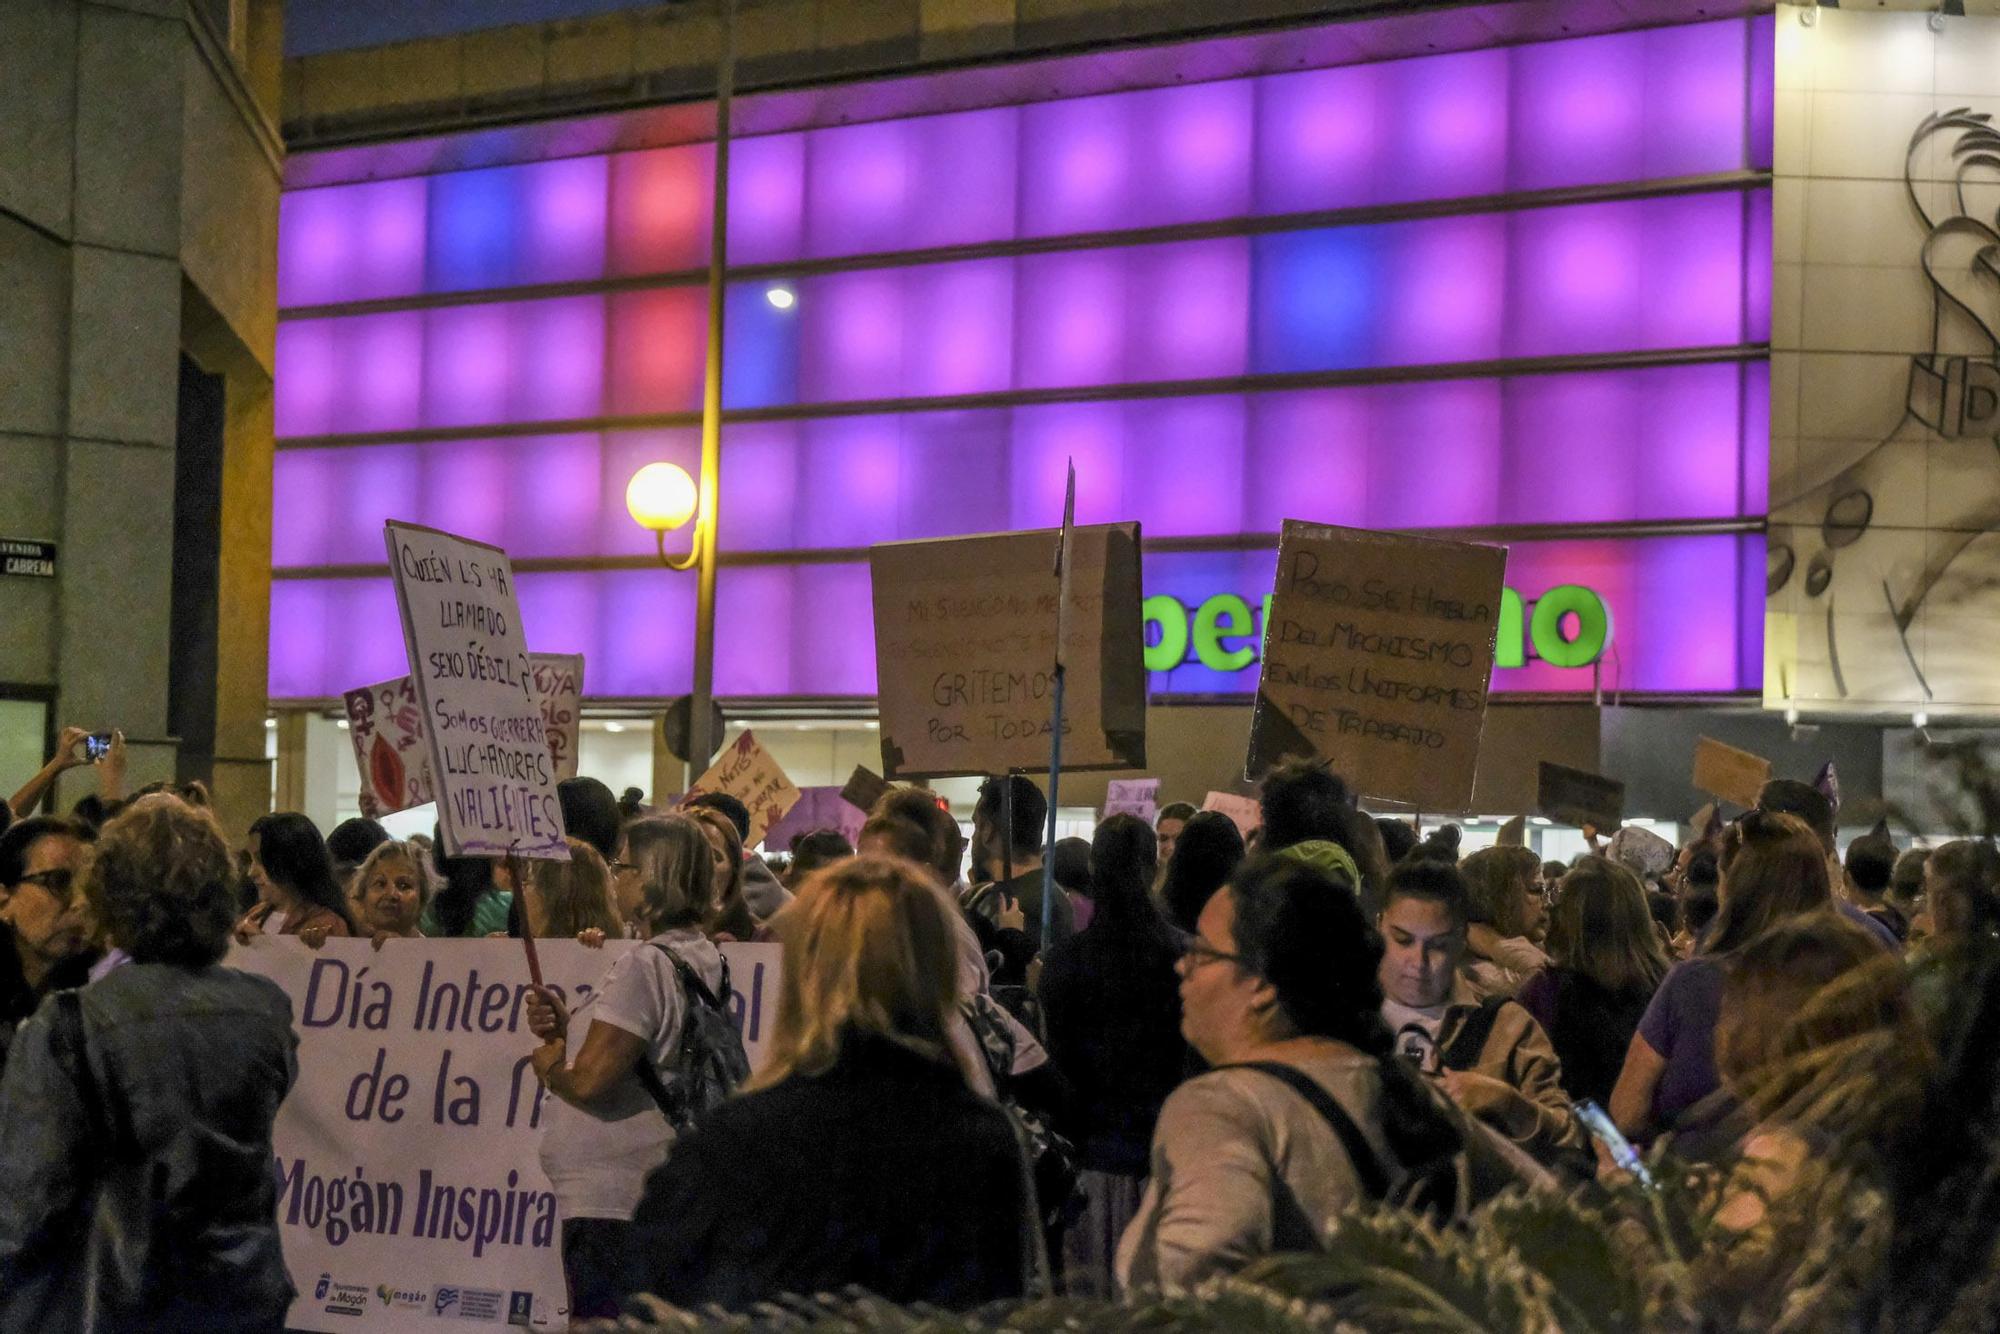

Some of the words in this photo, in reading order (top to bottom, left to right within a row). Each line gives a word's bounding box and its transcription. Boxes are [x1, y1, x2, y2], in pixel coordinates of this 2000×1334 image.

[0, 542, 42, 556] VENIDA
[440, 599, 506, 637] LLAMADO
[429, 652, 464, 679] SEXO
[1330, 621, 1473, 668] MACHISMO
[1348, 665, 1481, 712] UNIFORMES
[928, 718, 971, 743] POR
[1330, 707, 1445, 749] TRABAJO
[444, 743, 548, 786] LUCHADORAS
[454, 784, 560, 843] VALIENTES
[302, 958, 393, 1031] Día
[345, 1047, 410, 1122] de
[433, 1049, 481, 1126] la
[275, 1157, 403, 1247] Mogán
[412, 1168, 557, 1258] Inspira
